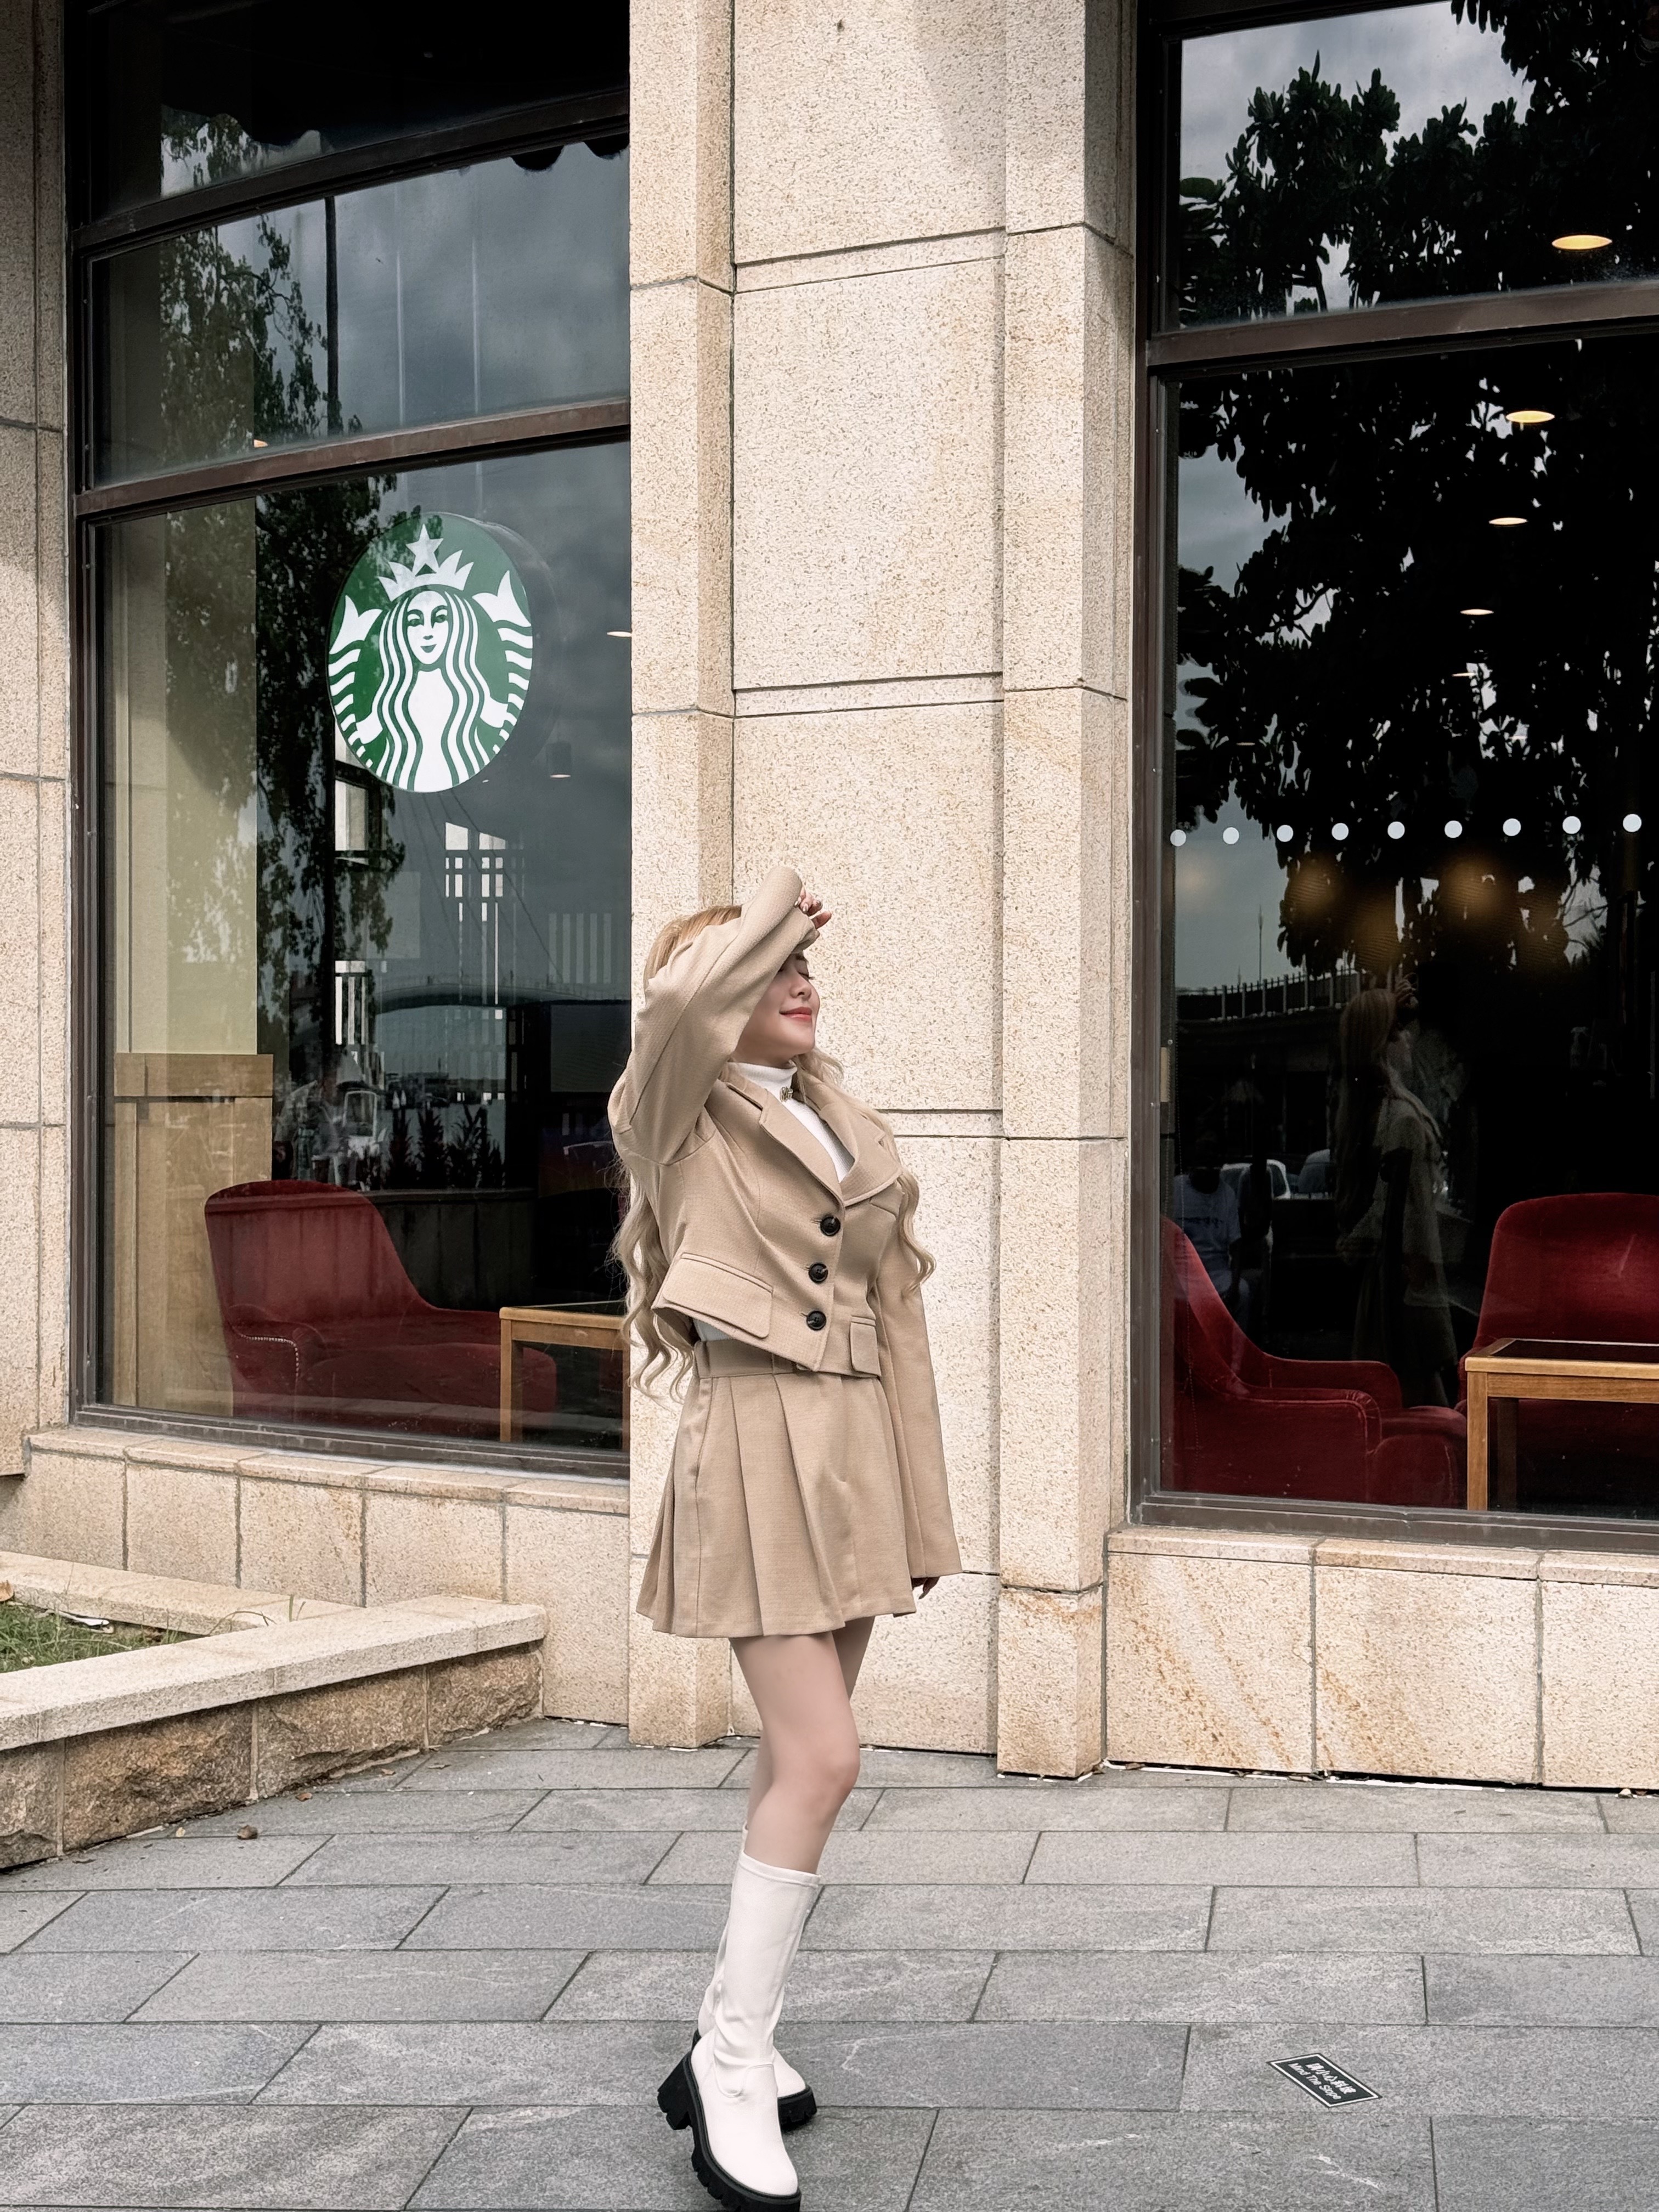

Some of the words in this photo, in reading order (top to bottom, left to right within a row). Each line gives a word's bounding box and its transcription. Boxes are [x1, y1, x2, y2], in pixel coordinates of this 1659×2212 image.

[1288, 2063, 1311, 2075] Mind
[1306, 2074, 1322, 2085] The
[1318, 2085, 1341, 2100] Slope
